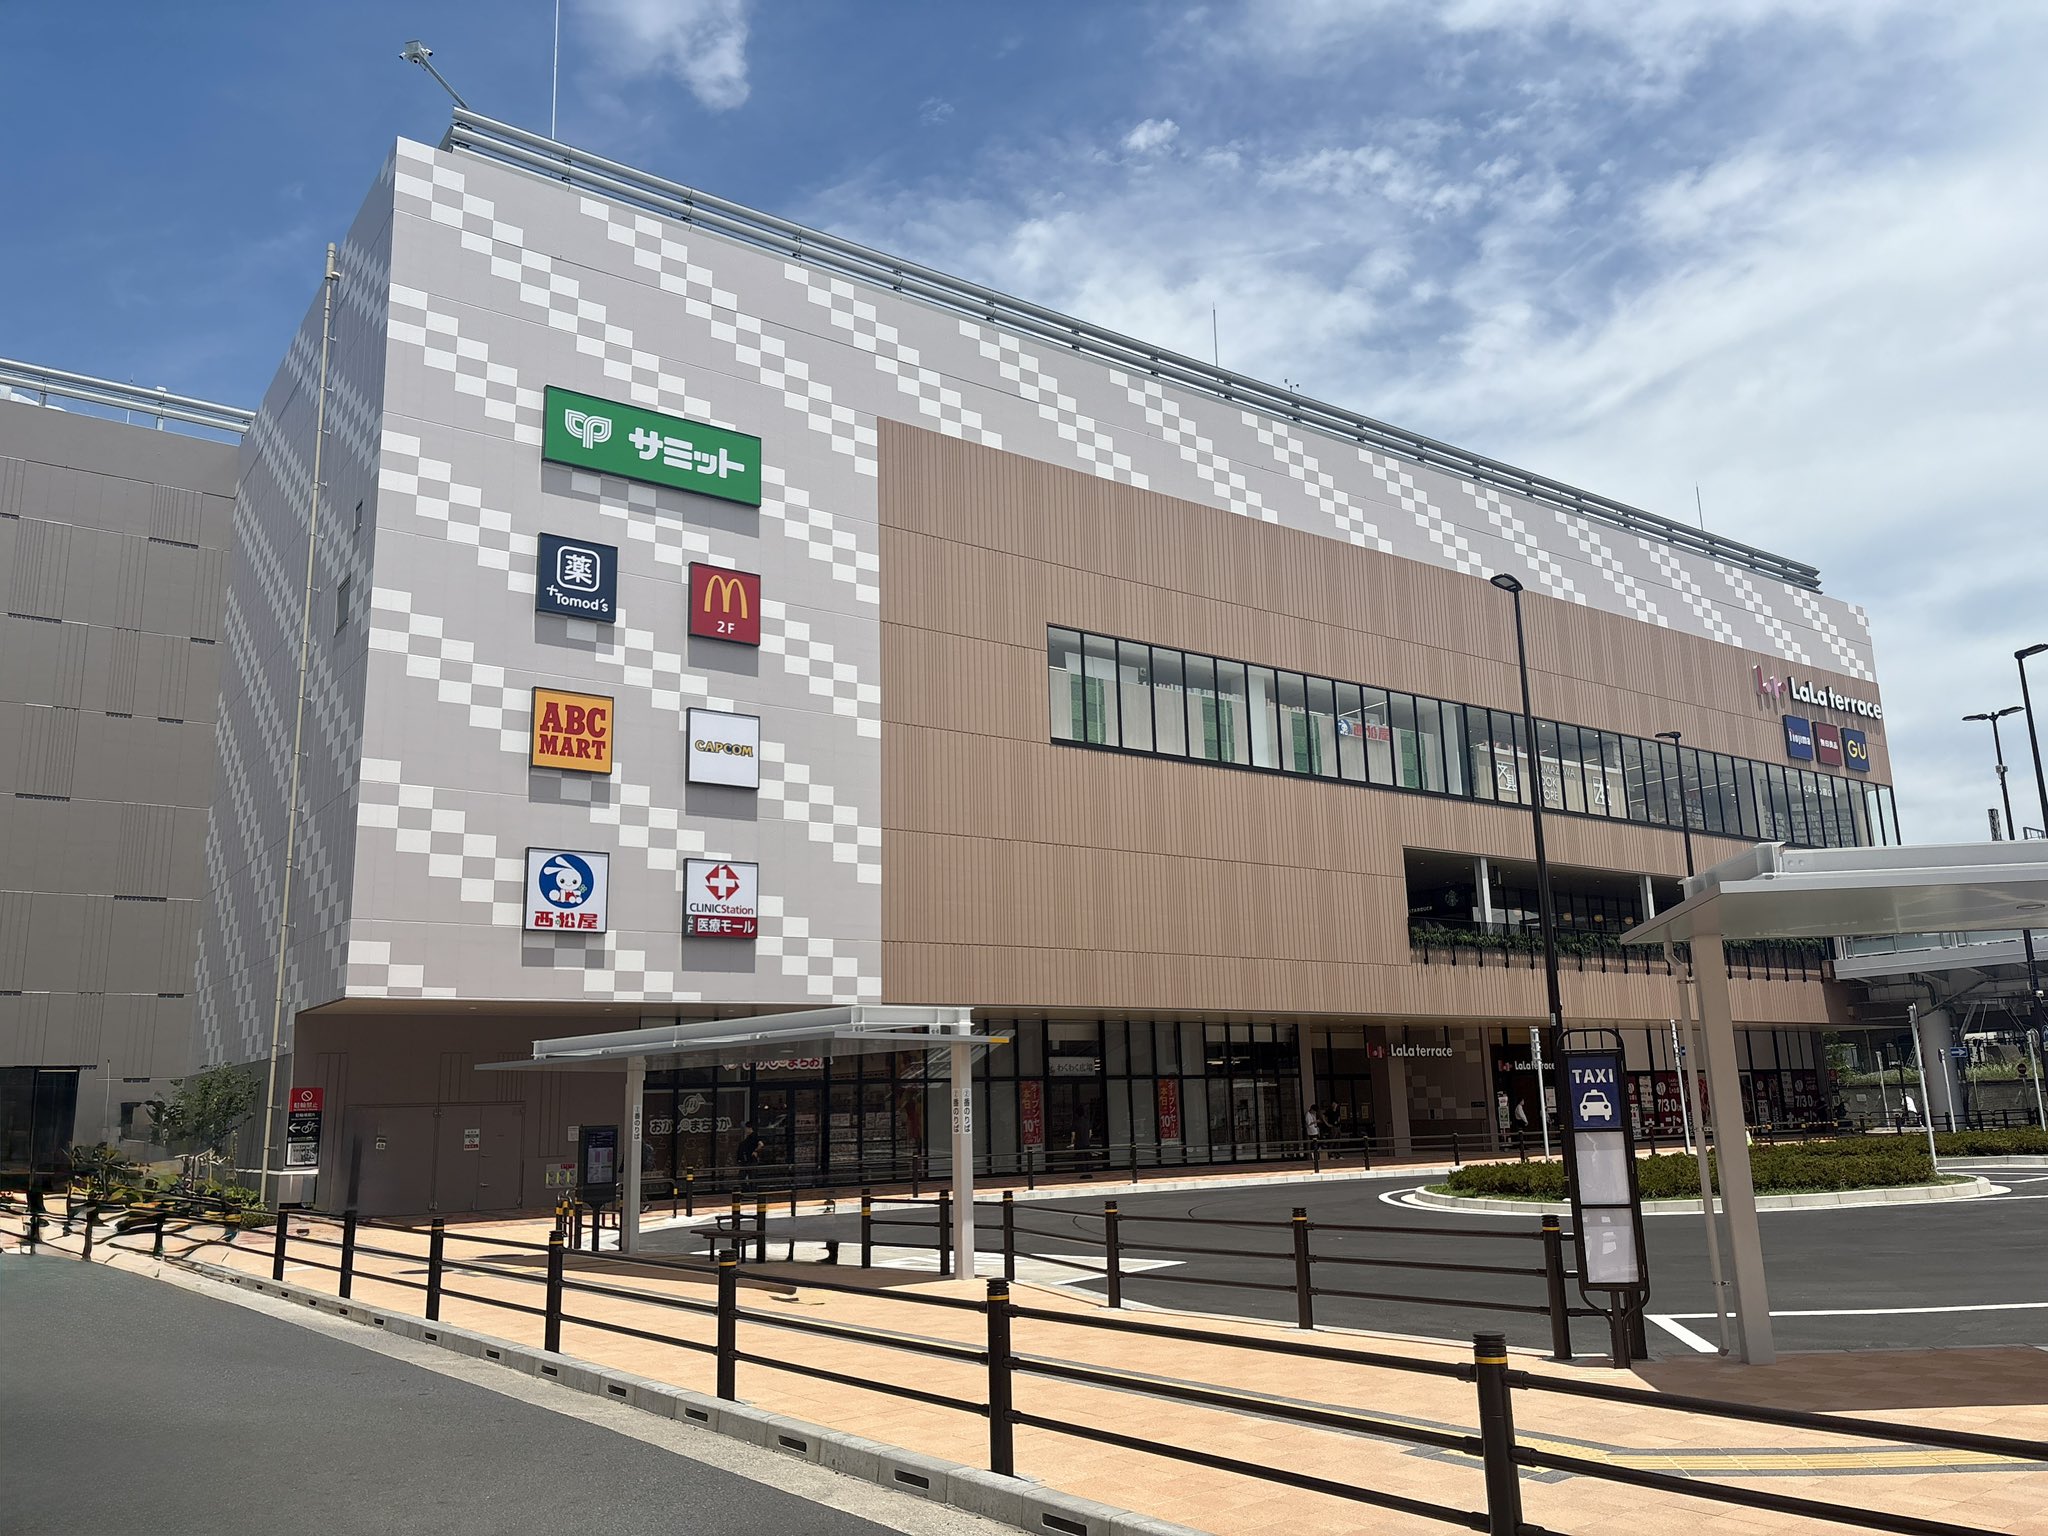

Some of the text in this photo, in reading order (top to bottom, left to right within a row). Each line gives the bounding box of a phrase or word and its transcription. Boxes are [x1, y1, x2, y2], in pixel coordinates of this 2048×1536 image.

[628, 427, 745, 479] サミット
[564, 554, 592, 585] 薬
[555, 591, 609, 613] Tomod's
[716, 620, 735, 634] 2F
[1788, 676, 1882, 720] LaLa terrace
[540, 701, 607, 738] ABC
[539, 733, 607, 761] MART
[695, 739, 754, 758] CAPCOM
[1847, 740, 1867, 760] GU
[534, 911, 598, 930] 西松屋
[697, 917, 755, 934] 医療モール
[1390, 1043, 1453, 1057] LaLa terrace
[1514, 1060, 1531, 1070] LaLa
[1571, 1068, 1614, 1084] TAXI
[1657, 1098, 1677, 1113] 7/30
[1023, 1119, 1034, 1133] 10
[1160, 1115, 1171, 1128] 10
